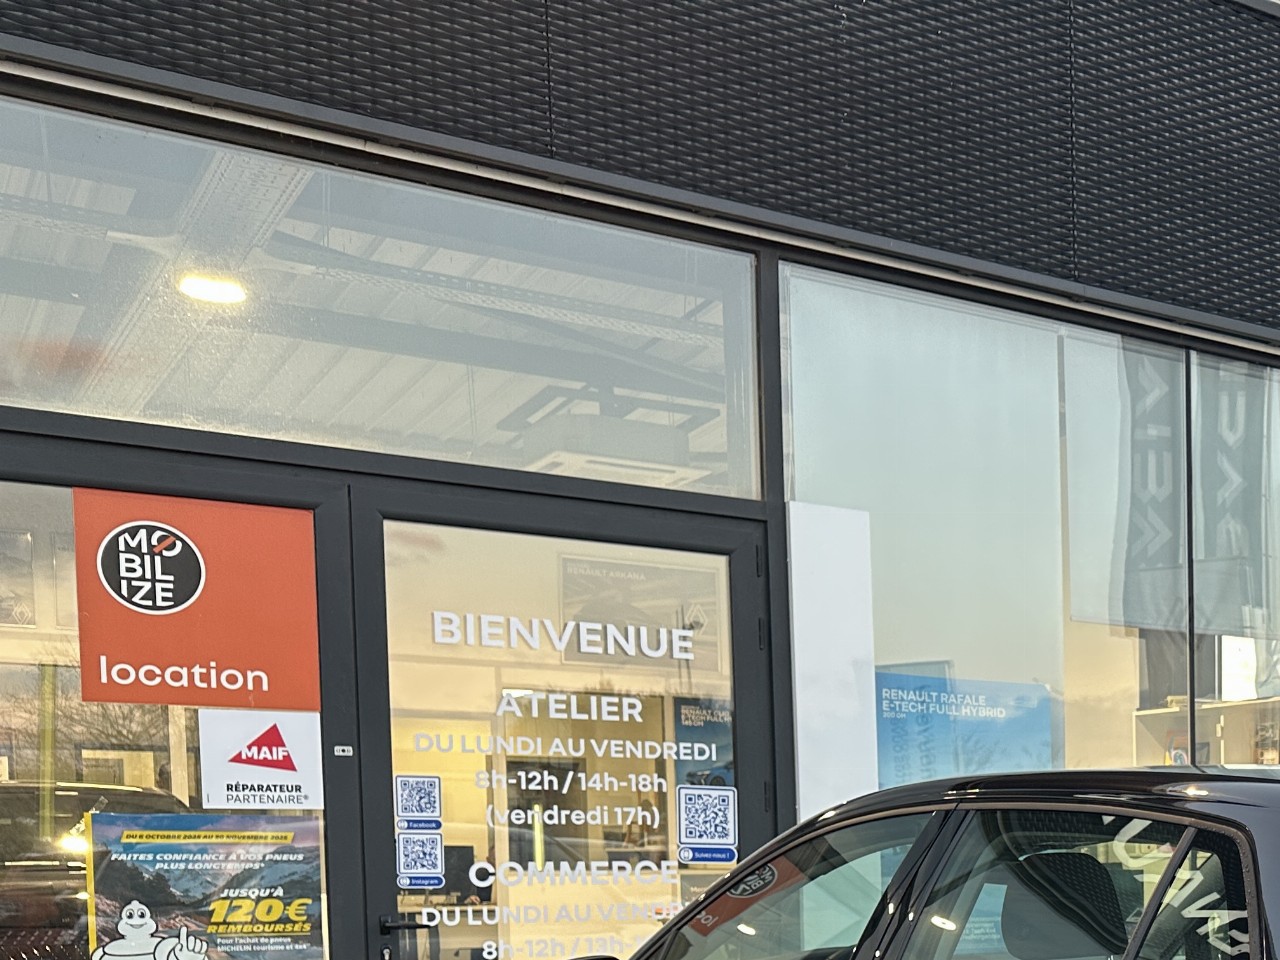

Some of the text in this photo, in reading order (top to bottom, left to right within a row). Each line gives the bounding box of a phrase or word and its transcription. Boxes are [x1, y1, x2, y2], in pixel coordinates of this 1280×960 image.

[432, 610, 695, 661] BIENVENUE
[100, 654, 270, 692] location
[496, 693, 643, 723] ATELIER
[882, 688, 986, 706] RENAULT RAFALE
[882, 700, 1006, 718] E-TECH FULL HYBRID
[241, 745, 289, 760] MAIF
[414, 733, 717, 761] DU LUNDI AU VENDREDI
[226, 781, 302, 793] RÉPARATEUR
[474, 770, 559, 791] 8h-12h
[578, 772, 667, 793] 14h-18h
[485, 805, 661, 829] (vendredi 17h)
[111, 853, 154, 861] FAITES
[155, 853, 226, 861] CONFIANCE
[240, 853, 263, 861] VOS
[265, 853, 304, 861] PNEUS
[155, 862, 187, 870] PLUS
[468, 860, 679, 888] COMMERCE
[220, 886, 284, 899] JUSQU'À
[208, 897, 313, 923] 120€
[421, 907, 461, 927] DU
[467, 905, 549, 926] LUNDI
[555, 904, 592, 923] AU
[206, 922, 312, 933] REMBOURSÉS
